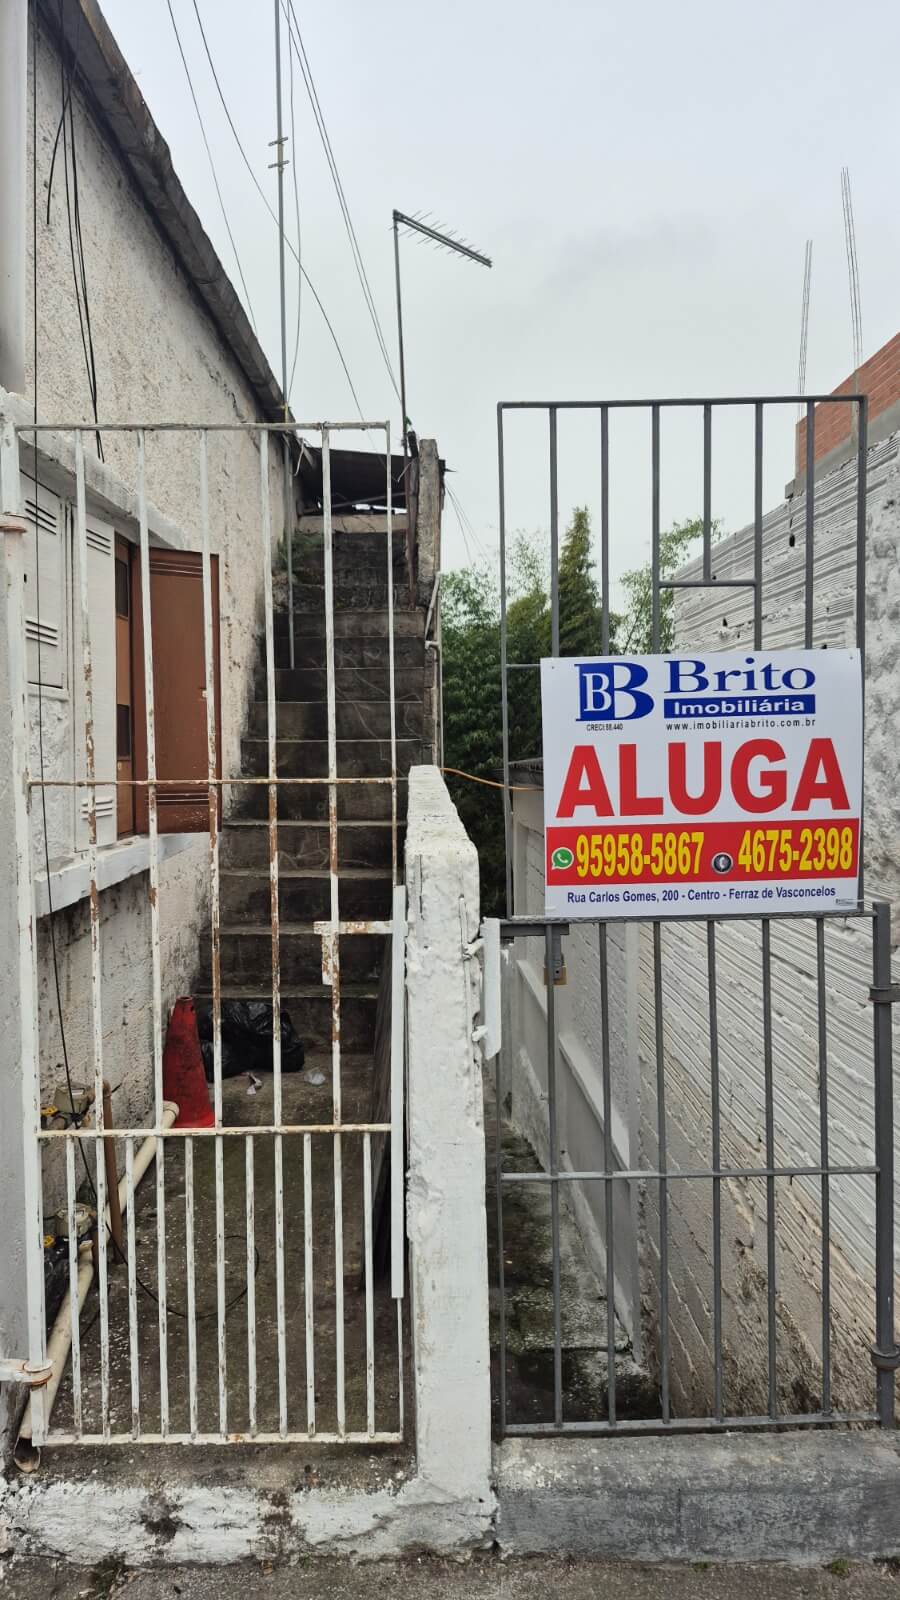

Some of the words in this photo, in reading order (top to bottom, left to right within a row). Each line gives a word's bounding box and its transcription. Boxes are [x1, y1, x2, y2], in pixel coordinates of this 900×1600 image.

[664, 657, 816, 693] Brito
[674, 699, 805, 715] Imobiliária
[666, 718, 816, 731] www.imobiliariabrito.com.br
[555, 738, 850, 818] ALUGA
[576, 831, 705, 877] 95958-5867
[738, 827, 853, 872] 4675-2398
[567, 892, 586, 903] Rua
[589, 891, 620, 902] Carlos
[623, 890, 660, 903] Gomes,
[662, 889, 679, 901] 200
[688, 888, 720, 901] Centro
[729, 888, 759, 899] Ferraz
[762, 887, 773, 898] de
[776, 886, 836, 897] Vasconcelos
